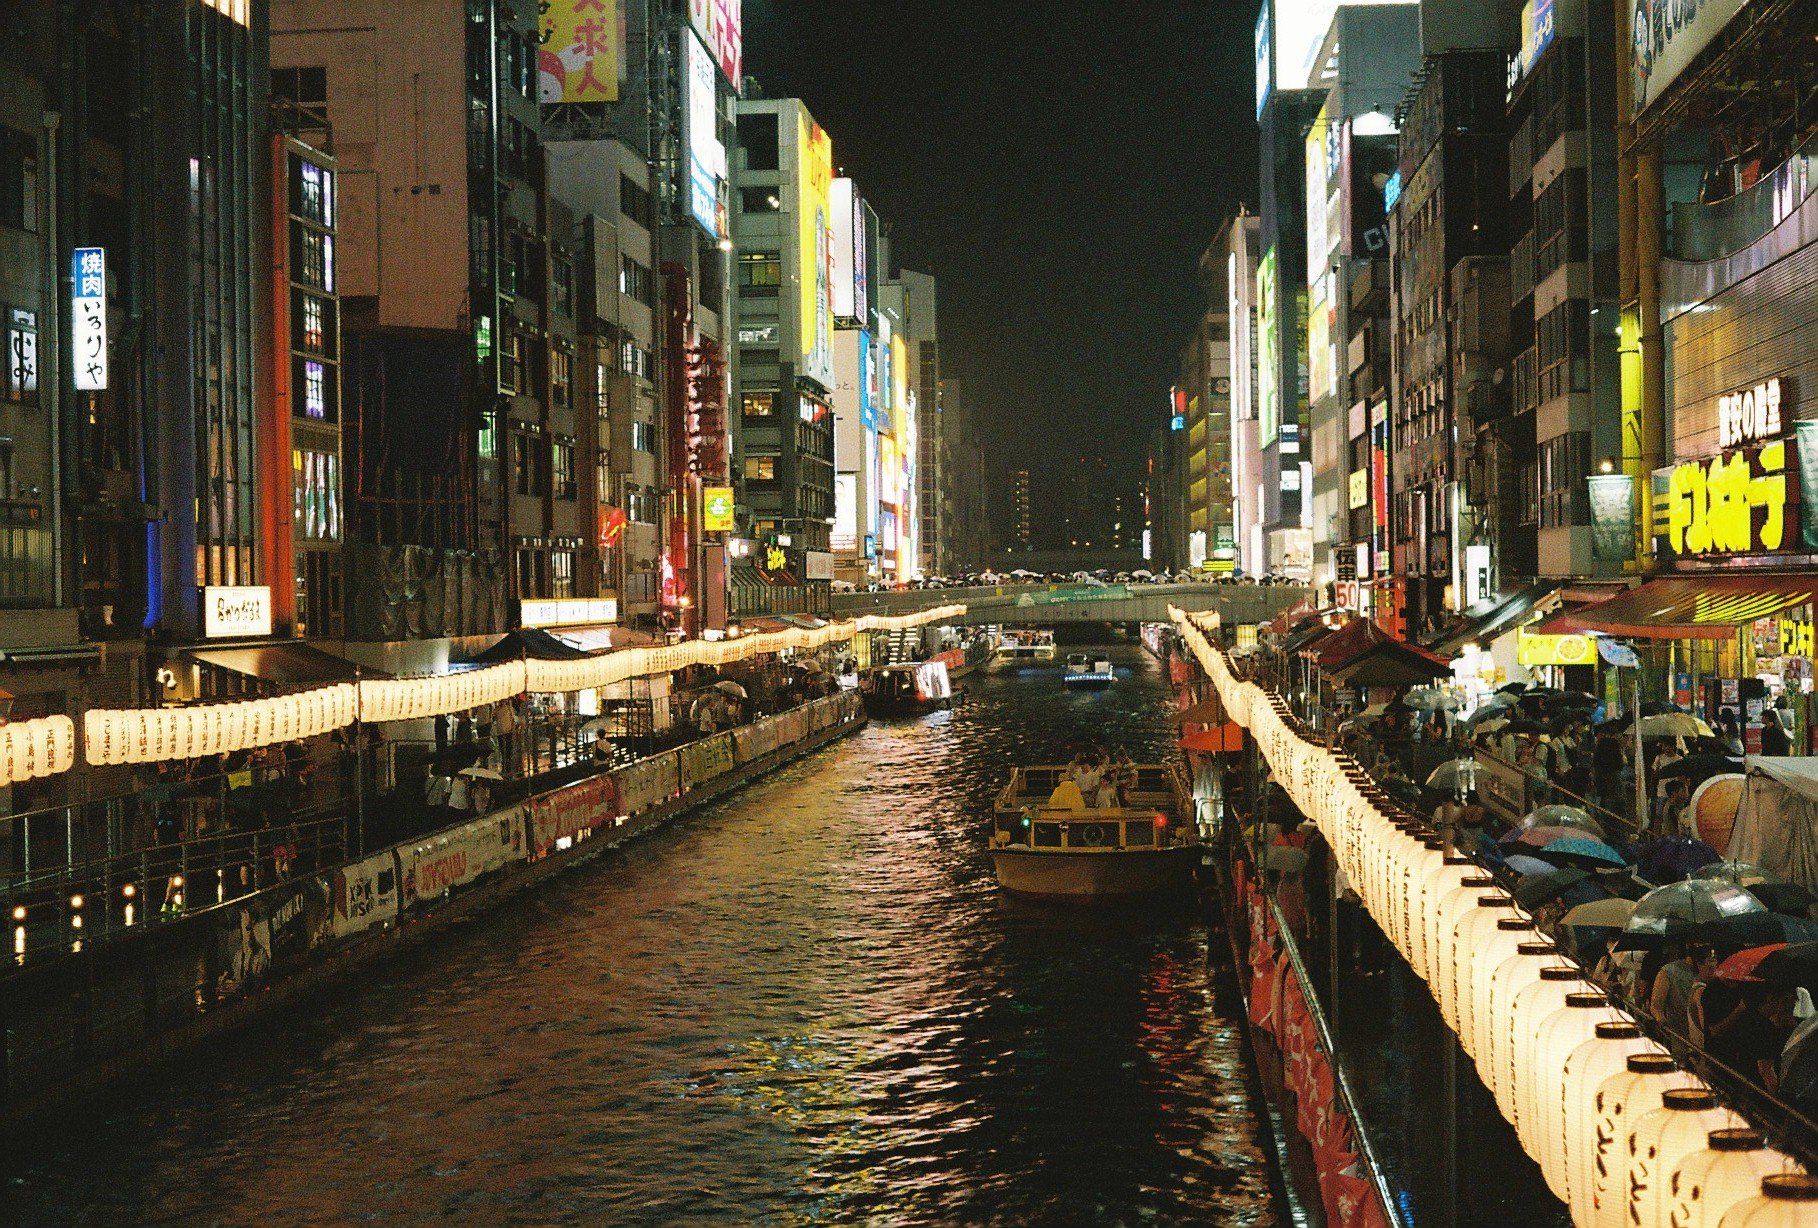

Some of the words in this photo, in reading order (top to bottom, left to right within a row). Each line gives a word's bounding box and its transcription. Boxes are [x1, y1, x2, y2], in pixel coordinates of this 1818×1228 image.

[572, 0, 608, 95] 求人
[80, 252, 102, 296] 焼肉
[83, 301, 104, 385] いろりや
[1336, 584, 1357, 607] 50
